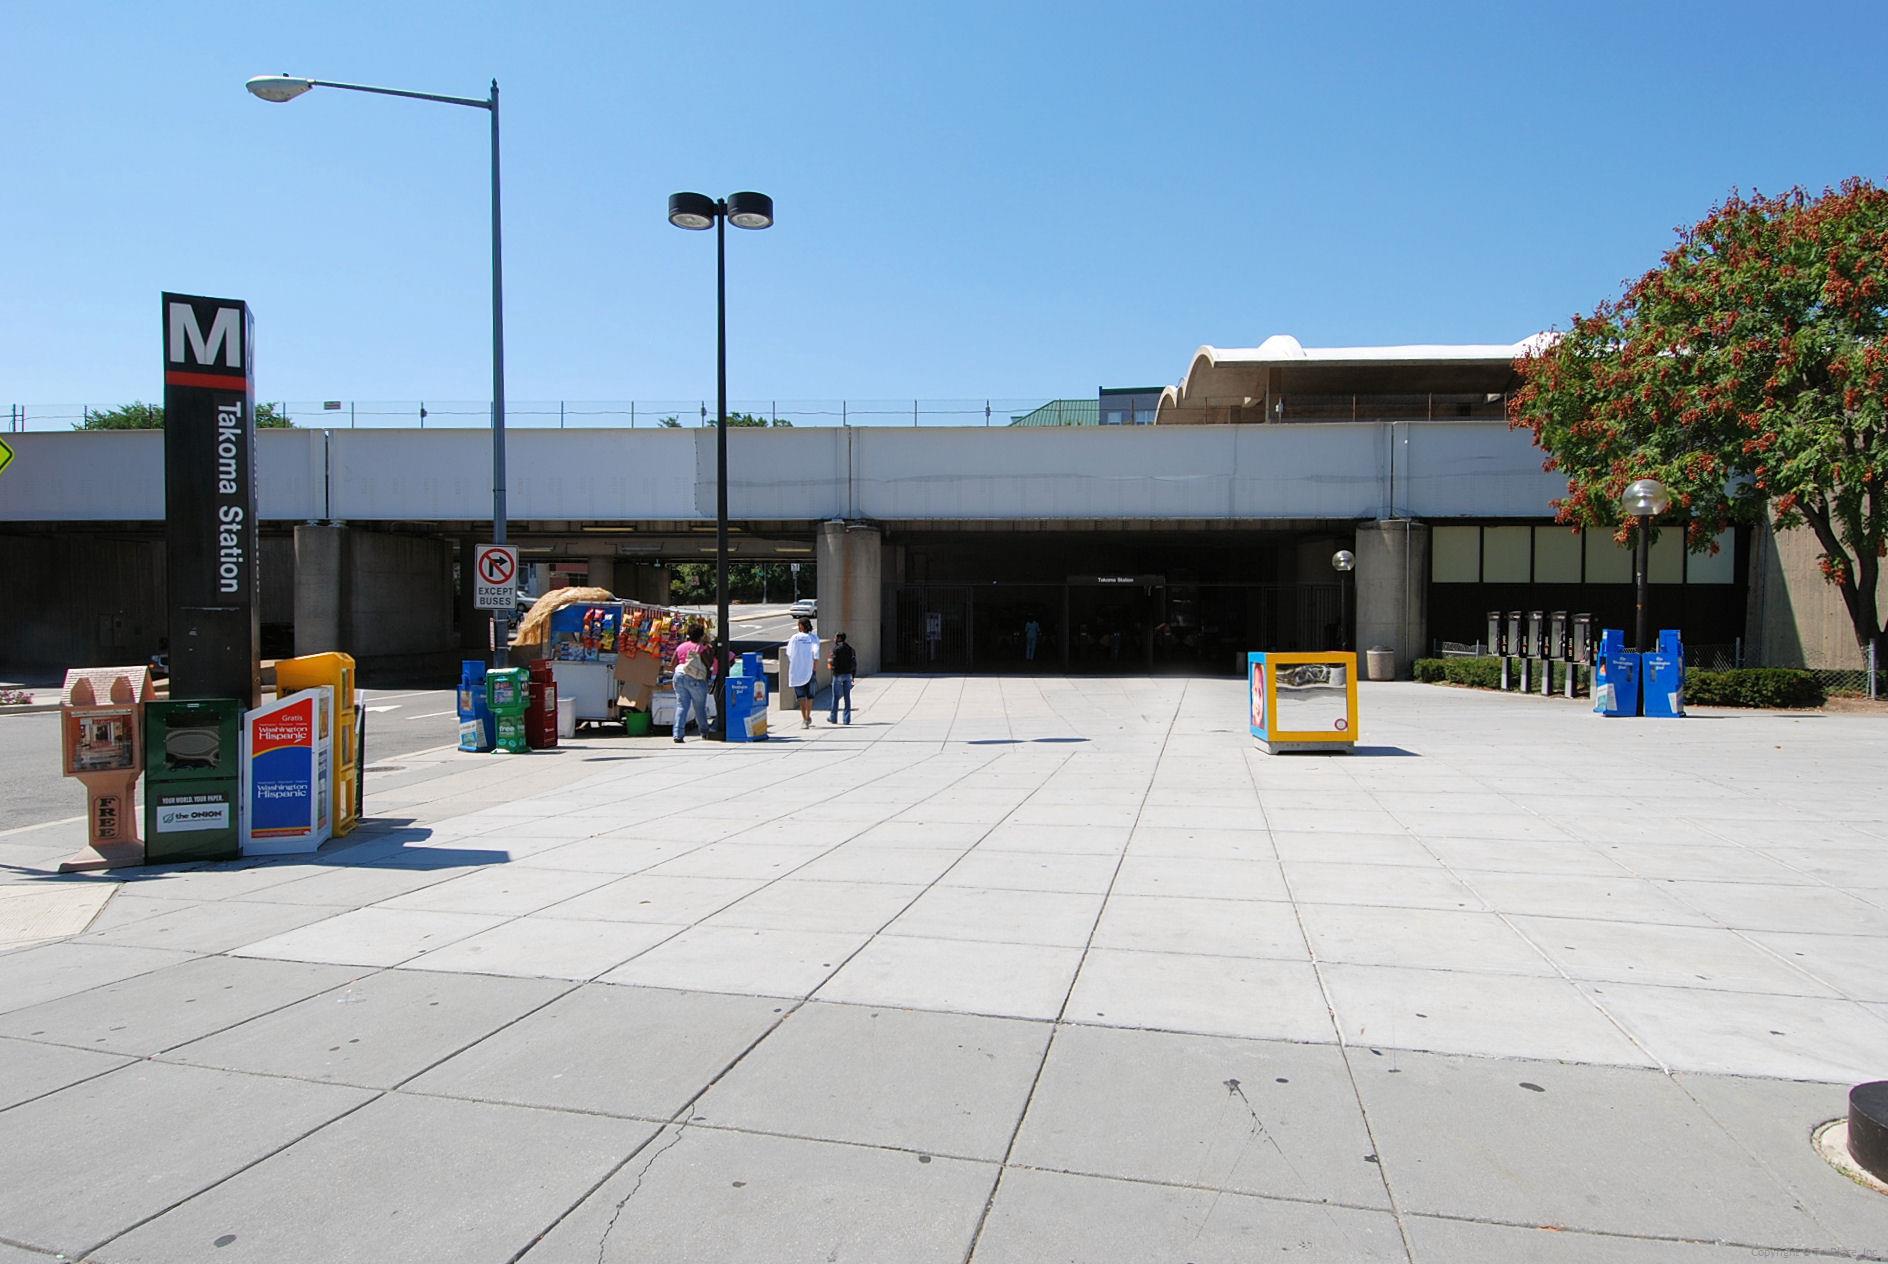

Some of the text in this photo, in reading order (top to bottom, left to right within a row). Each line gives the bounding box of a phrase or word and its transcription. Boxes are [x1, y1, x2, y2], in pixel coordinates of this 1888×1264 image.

[168, 301, 241, 368] M
[217, 401, 244, 594] Takoma Station
[478, 587, 513, 596] EXCEPT
[480, 597, 511, 606] BUSES
[281, 714, 303, 723] Gratis
[258, 726, 308, 734] Washington
[258, 731, 307, 743] Hispanic
[257, 783, 308, 791] Washington
[257, 788, 307, 799] Hispanic
[98, 797, 118, 838] FREE
[190, 810, 222, 819] ONION
